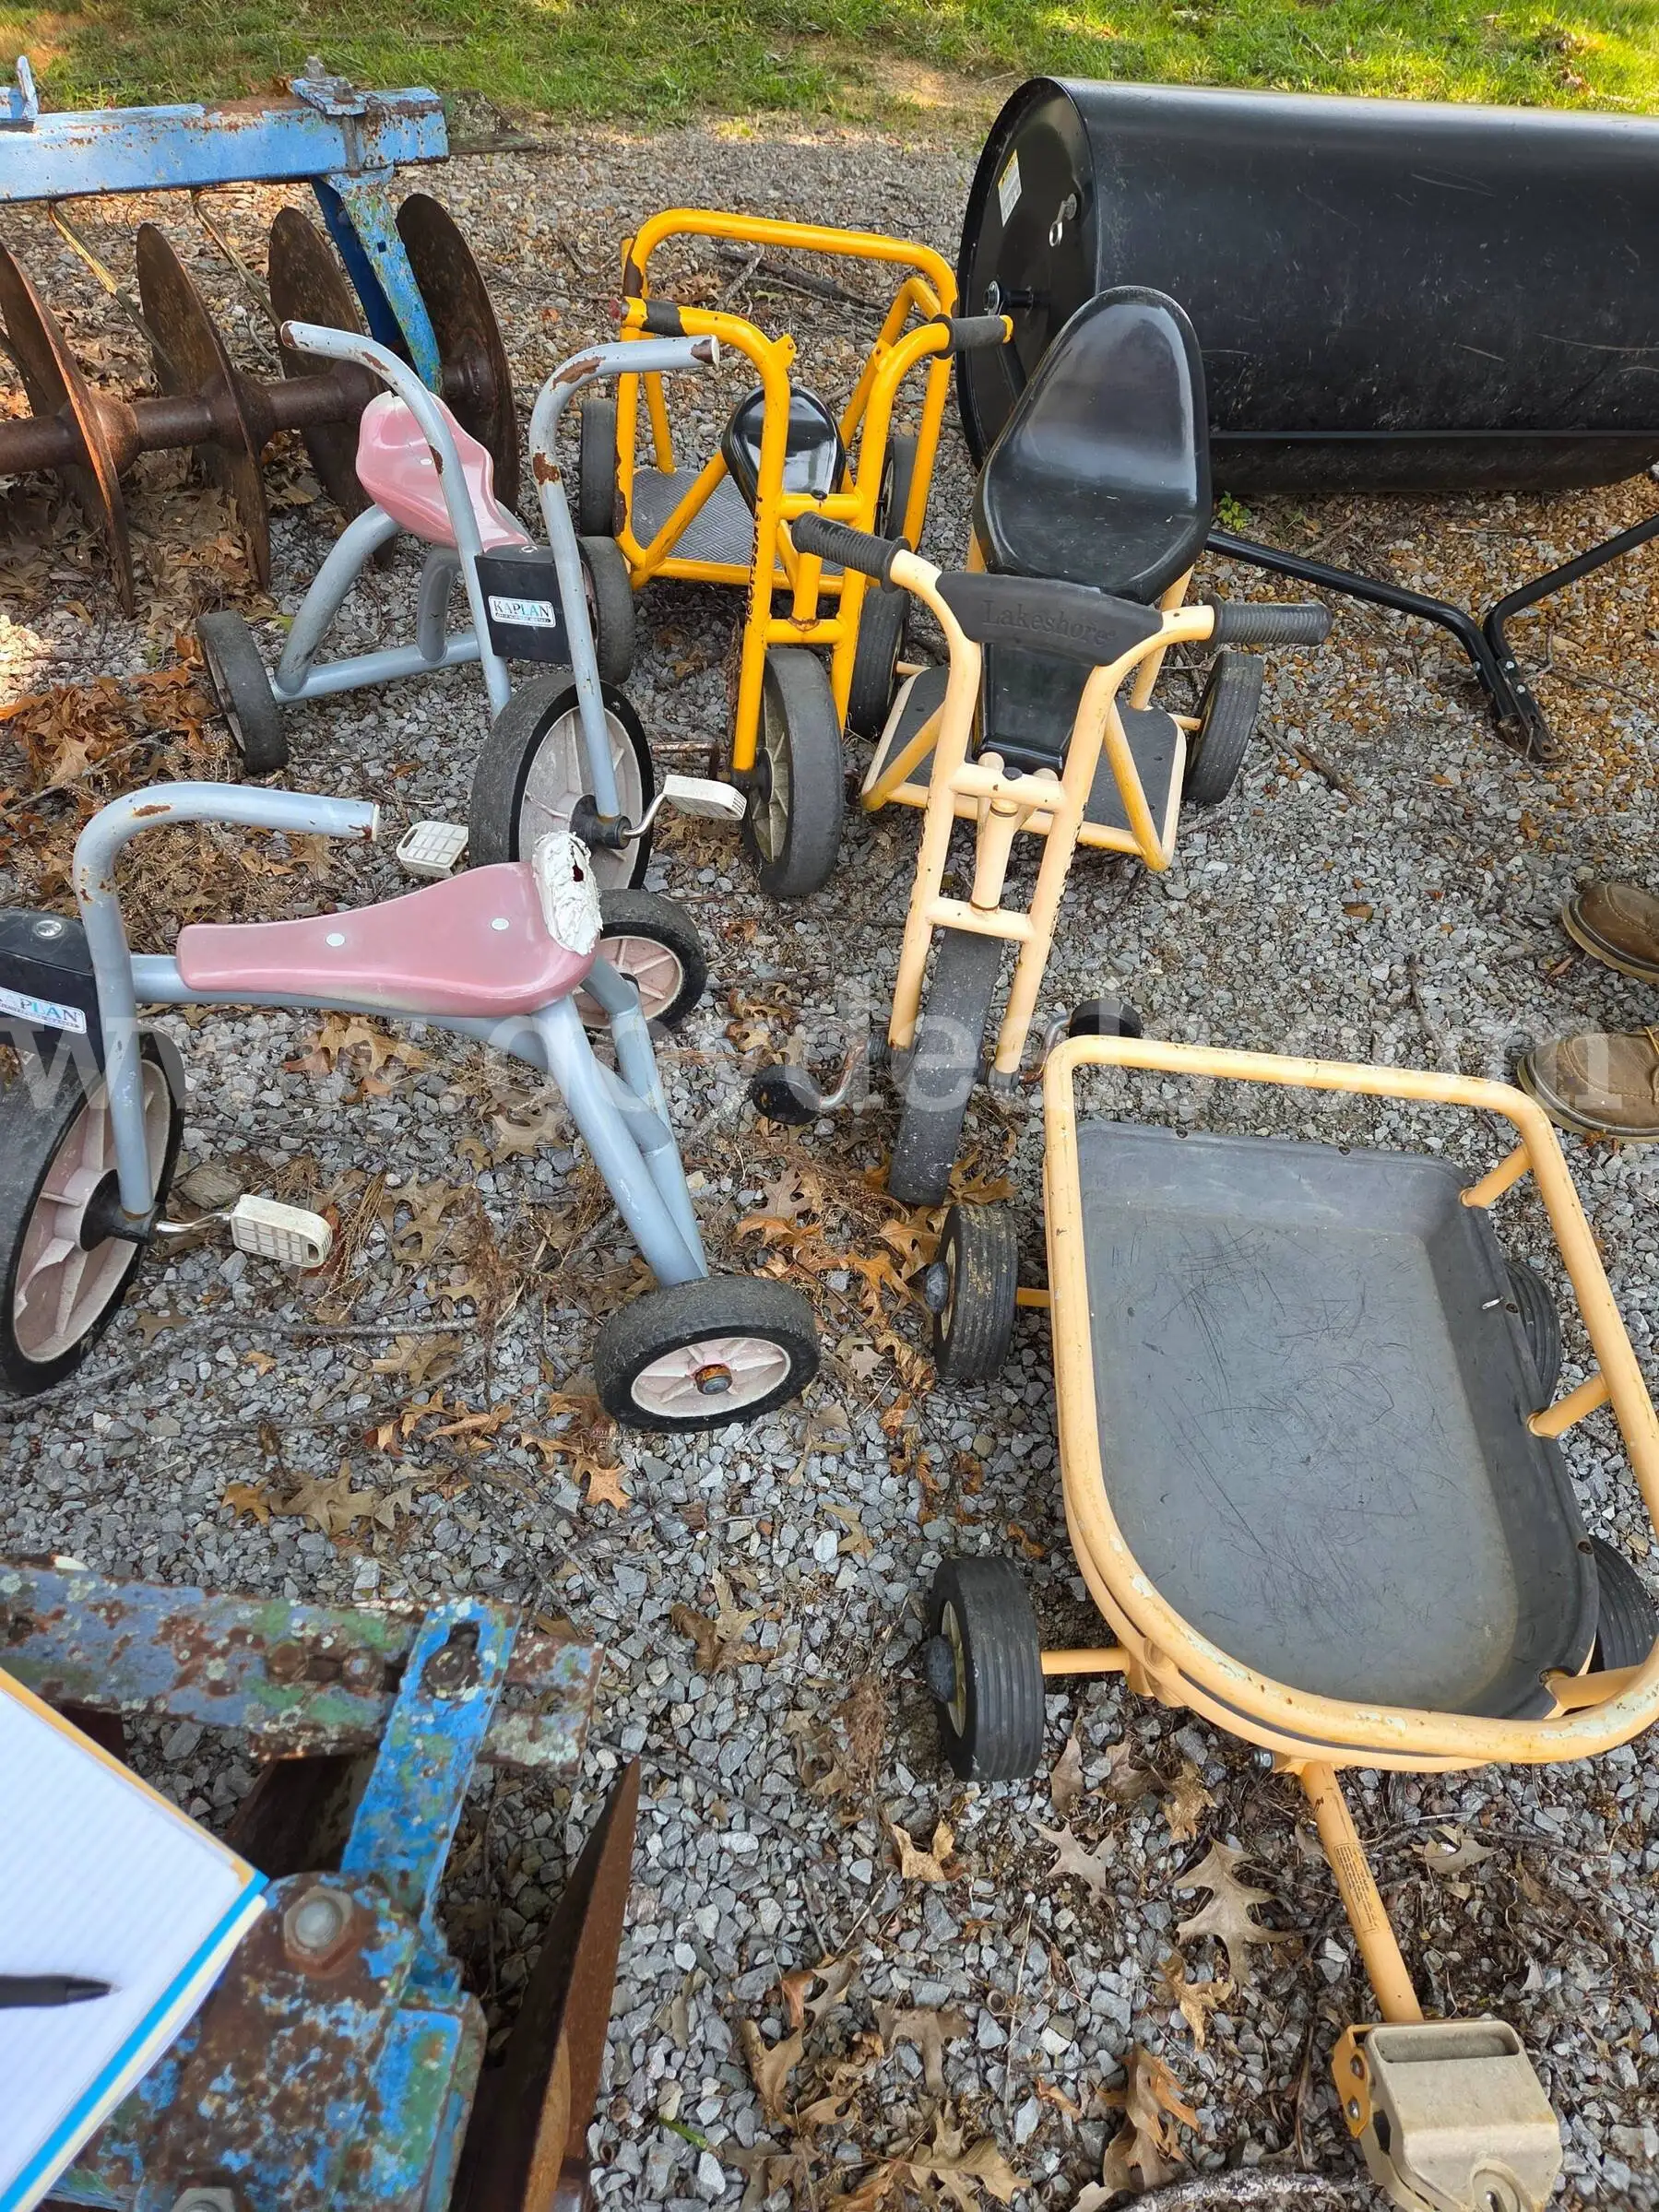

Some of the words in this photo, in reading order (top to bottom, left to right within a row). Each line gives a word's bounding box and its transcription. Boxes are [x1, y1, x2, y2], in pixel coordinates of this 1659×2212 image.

[493, 600, 550, 618] KAPLAN
[982, 600, 1107, 645] Lakeshore
[0, 994, 77, 1023] APLAN
